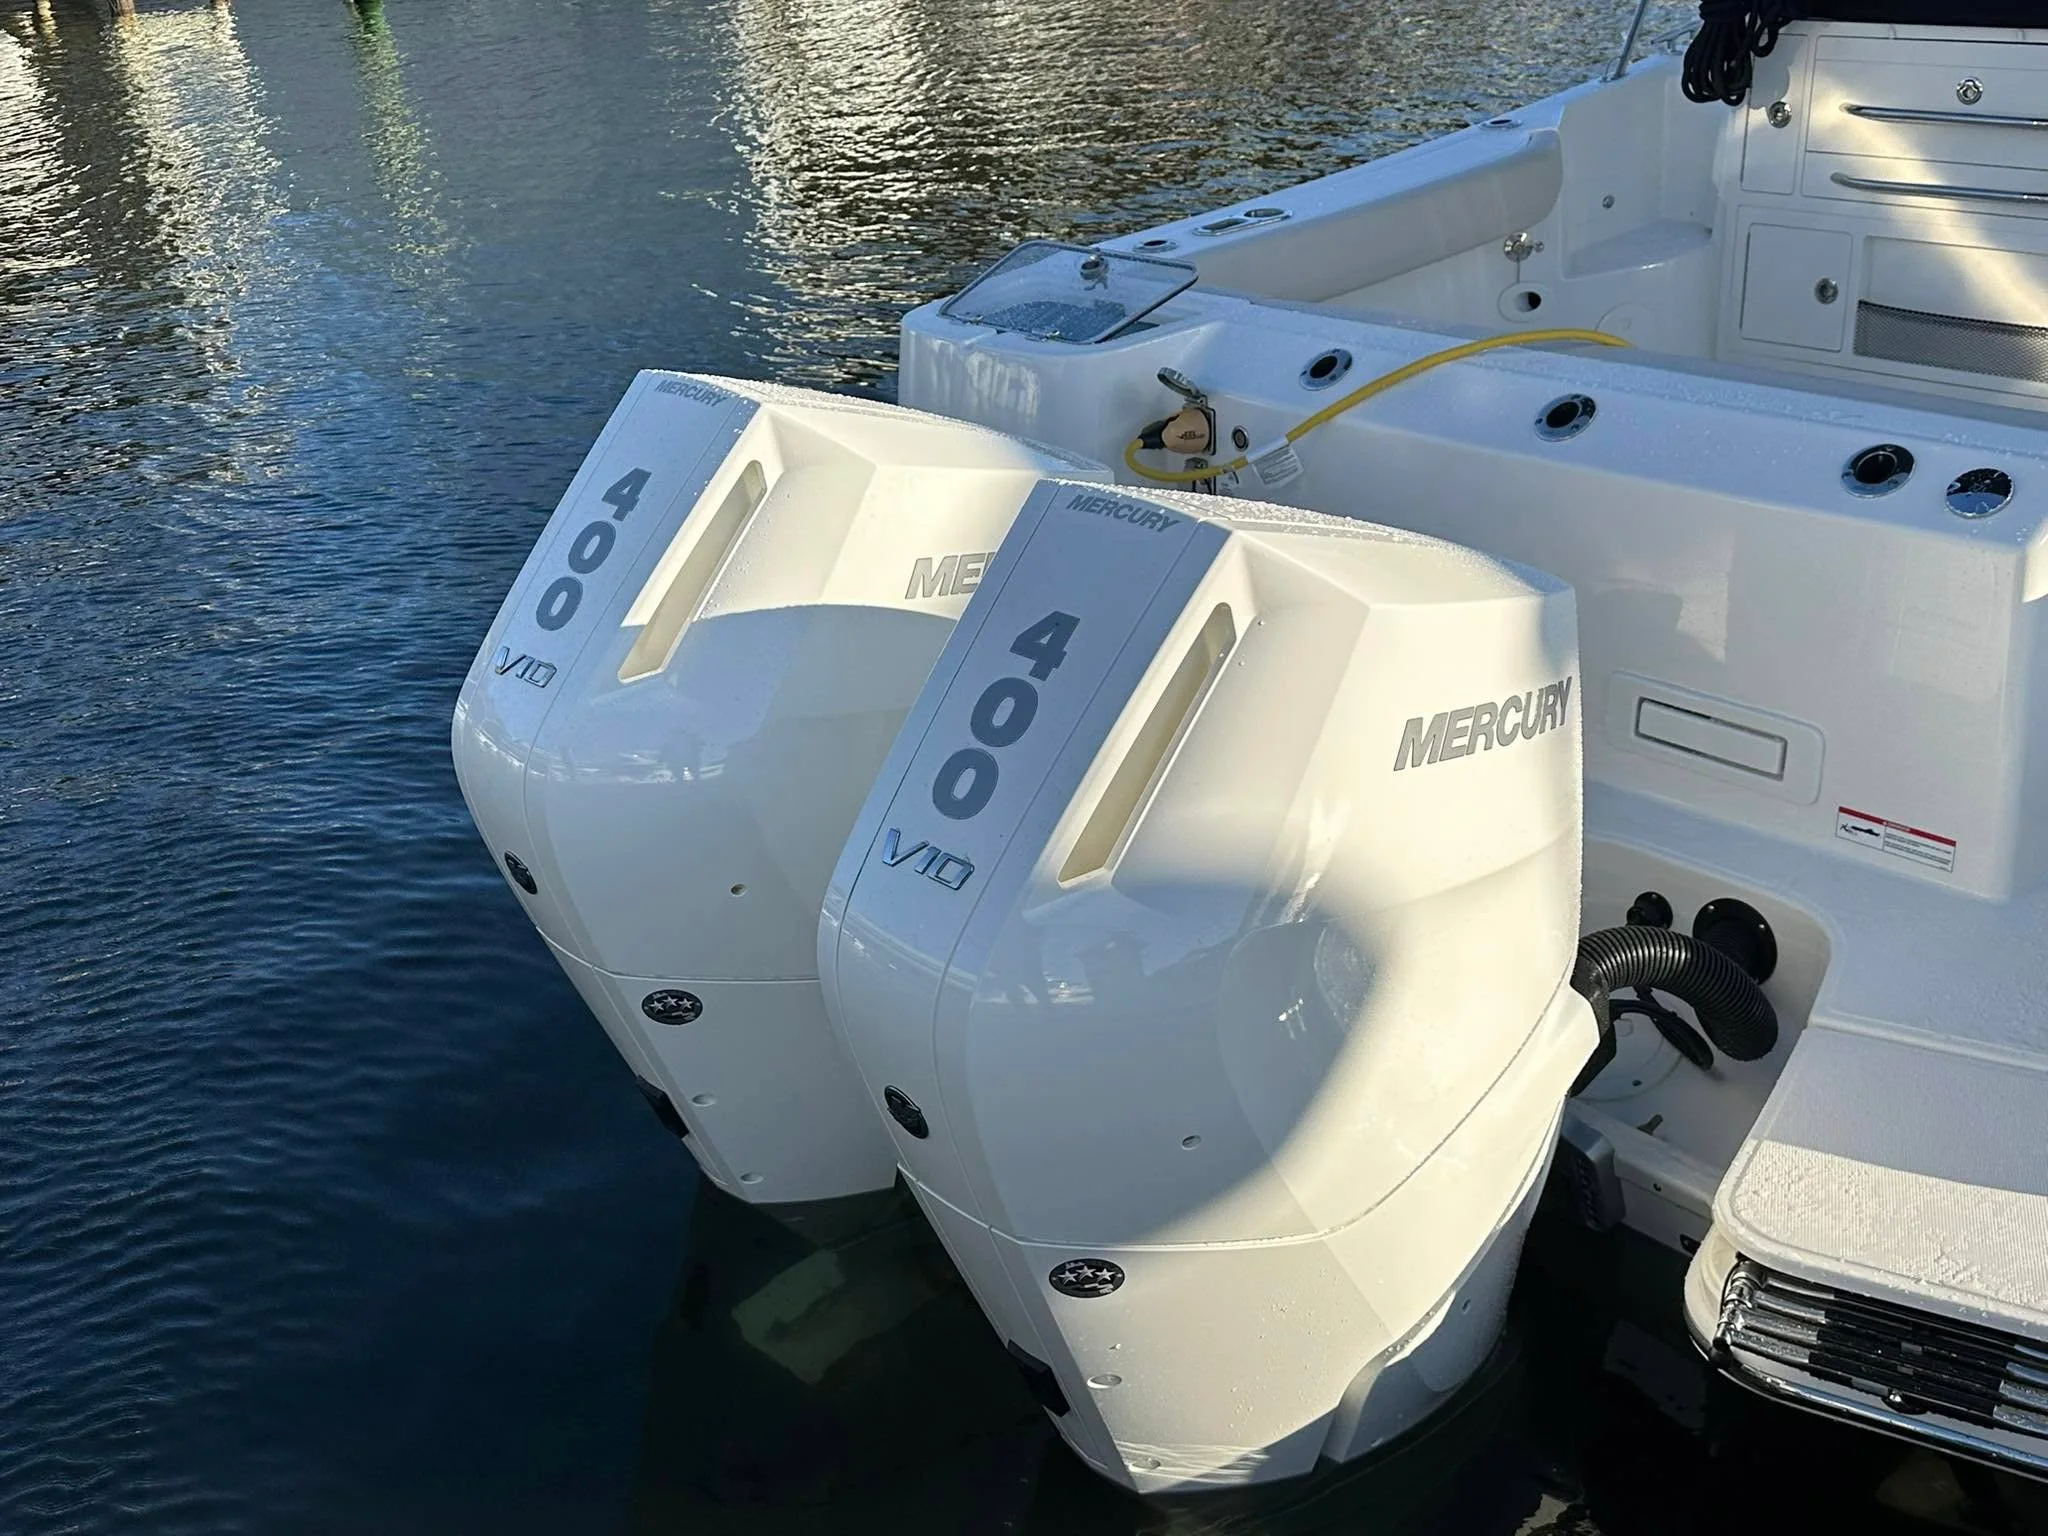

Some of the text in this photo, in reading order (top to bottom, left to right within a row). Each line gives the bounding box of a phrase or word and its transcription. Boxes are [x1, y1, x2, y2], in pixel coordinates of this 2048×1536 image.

[654, 379, 728, 407] MERCURY
[1066, 493, 1181, 533] MERCURY
[535, 467, 652, 631] 400
[904, 551, 997, 600] ME
[495, 646, 557, 688] V10
[932, 610, 1081, 820] 400
[1393, 676, 1573, 772] MERCURY
[882, 827, 975, 891] V10
